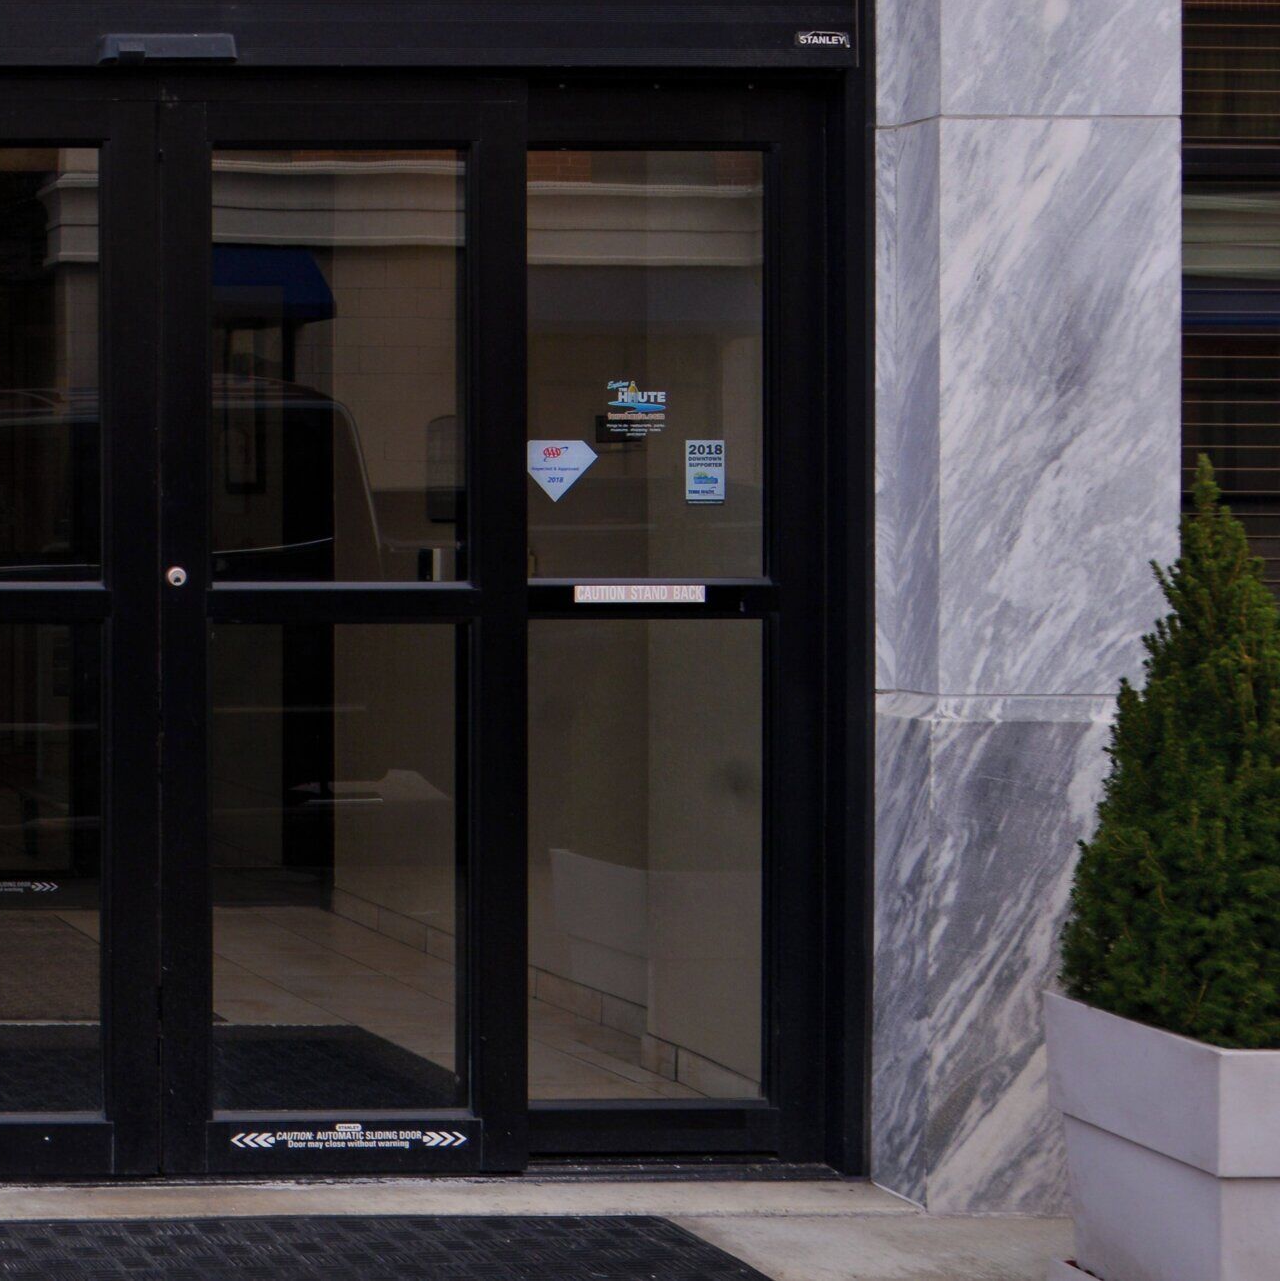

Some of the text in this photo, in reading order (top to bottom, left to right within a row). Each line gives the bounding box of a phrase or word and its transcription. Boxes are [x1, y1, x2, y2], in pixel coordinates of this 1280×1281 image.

[799, 35, 845, 44] STANLEY
[544, 447, 561, 458] AAA
[689, 445, 722, 455] 2018
[577, 586, 703, 600] CAUTION STAND BACK
[278, 1131, 422, 1140] CAUTION: AUTOMATIC SLIDING DOOR
[308, 1141, 323, 1149] may
[378, 1141, 410, 1149] warning
